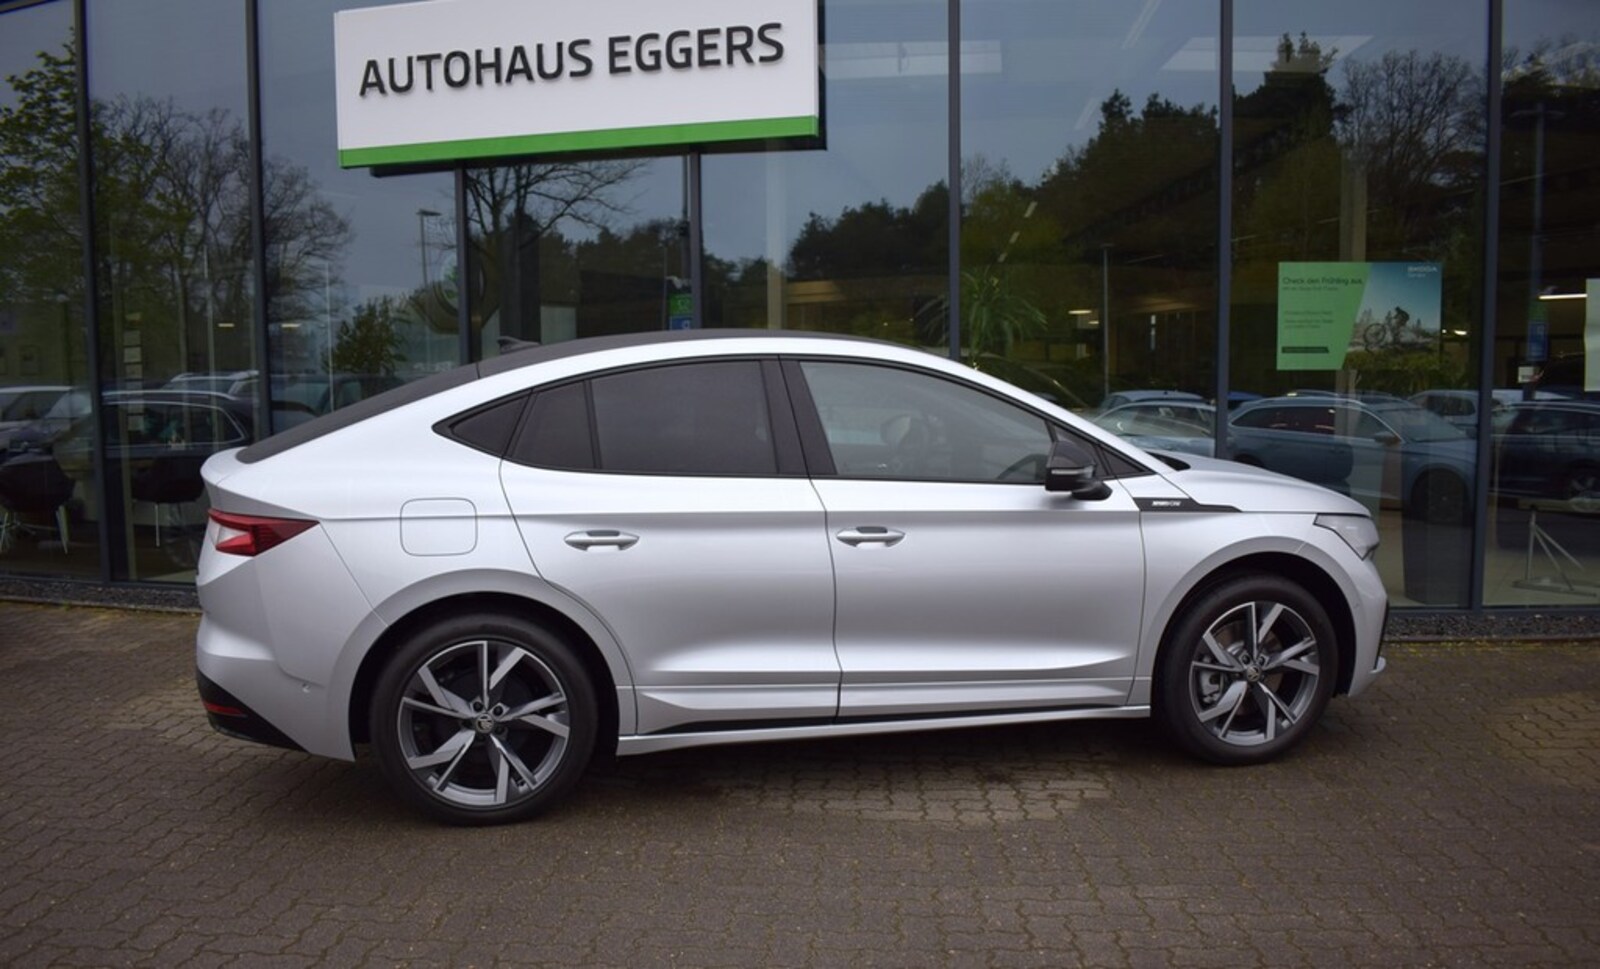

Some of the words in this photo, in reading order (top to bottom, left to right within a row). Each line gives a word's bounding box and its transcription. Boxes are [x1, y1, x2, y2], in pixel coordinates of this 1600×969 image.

[360, 39, 593, 97] AUTOHAUS
[608, 23, 784, 74] EGGERS
[1282, 276, 1304, 285] Check
